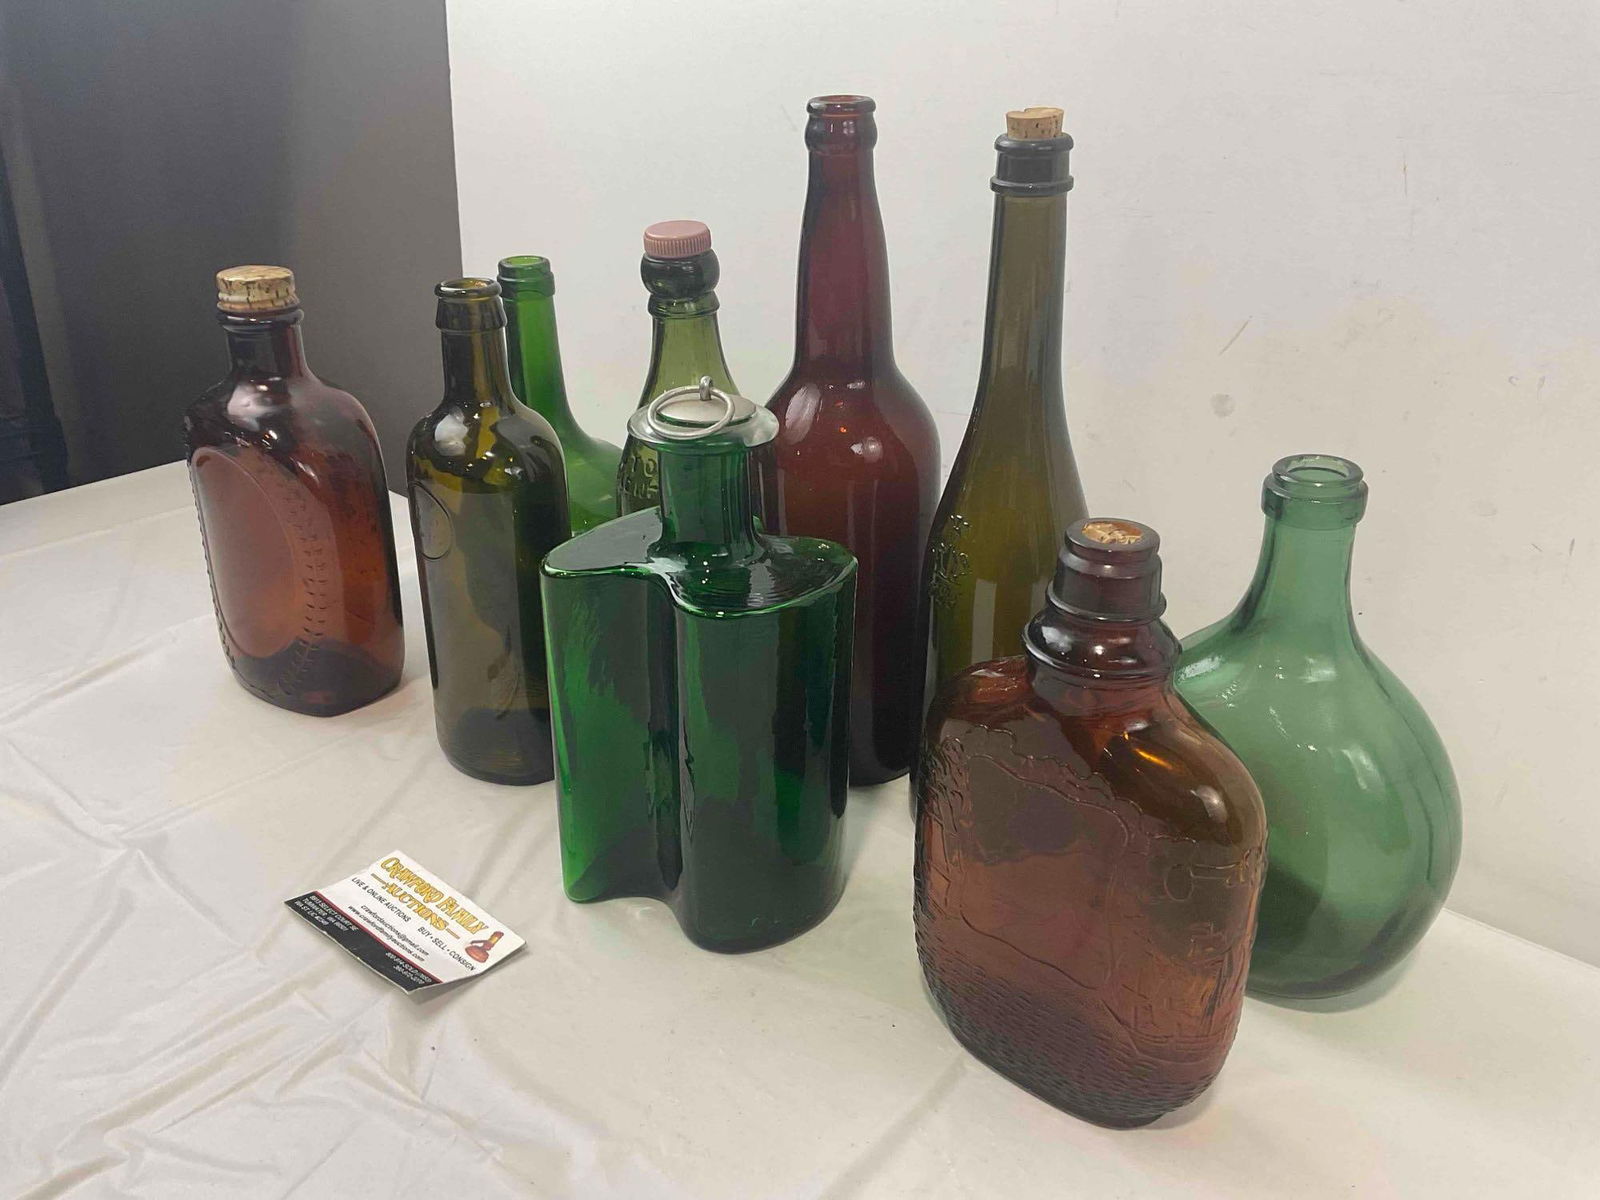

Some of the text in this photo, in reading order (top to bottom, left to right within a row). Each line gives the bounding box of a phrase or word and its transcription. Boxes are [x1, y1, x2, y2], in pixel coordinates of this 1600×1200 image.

[352, 877, 365, 887] LIVE
[367, 888, 387, 903] ONLINE
[384, 901, 411, 922] AUCTIONS
[418, 926, 476, 971] BUY SELL CONSIGN
